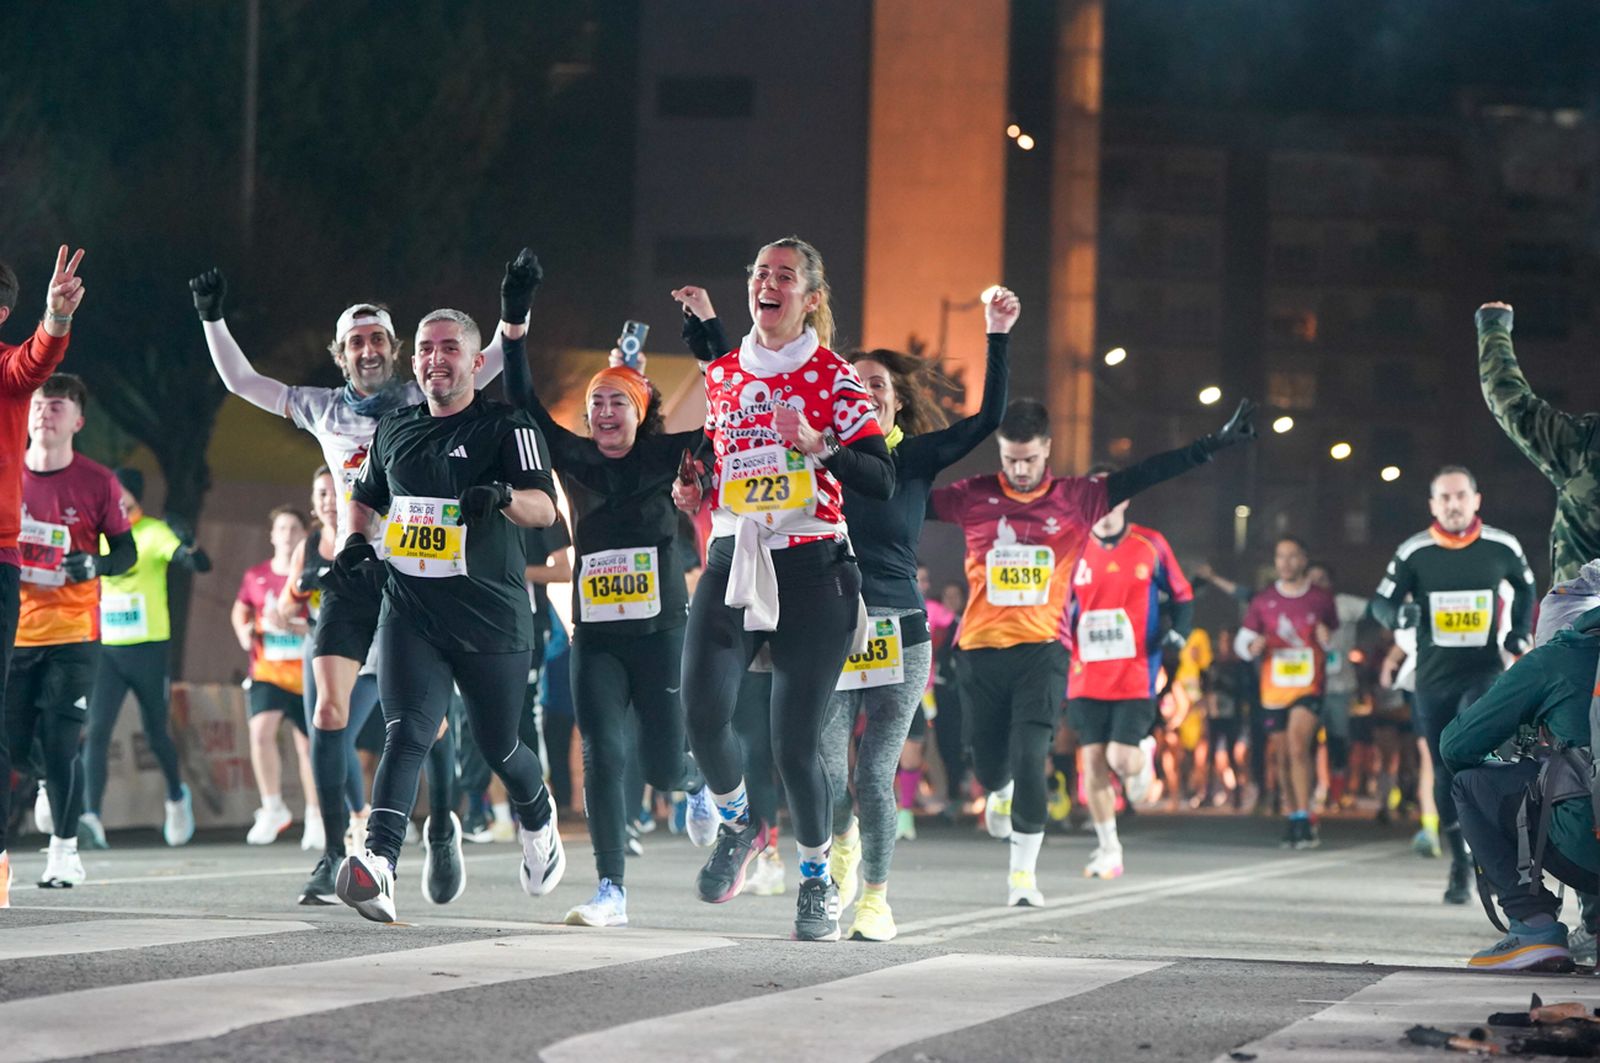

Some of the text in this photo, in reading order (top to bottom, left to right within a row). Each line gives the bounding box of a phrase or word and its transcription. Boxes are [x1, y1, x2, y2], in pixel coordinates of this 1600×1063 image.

[742, 457, 765, 468] NOCHE
[766, 454, 777, 465] DE
[731, 470, 748, 481] SAN
[745, 475, 790, 503] 223
[425, 505, 435, 515] DE
[399, 525, 446, 551] 7789
[1000, 567, 1042, 585] 4388
[588, 573, 648, 598] 13408
